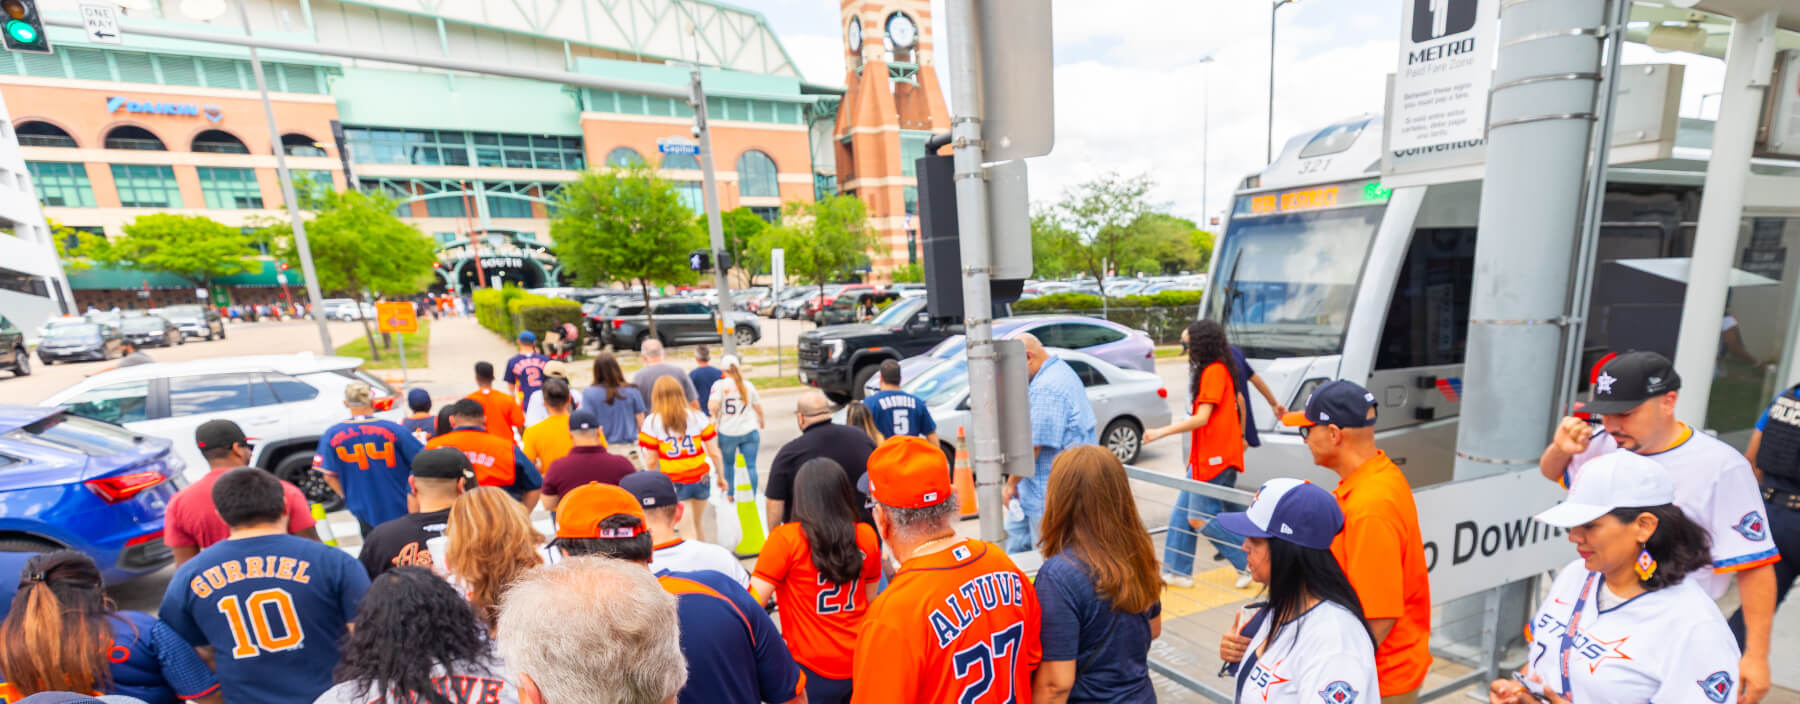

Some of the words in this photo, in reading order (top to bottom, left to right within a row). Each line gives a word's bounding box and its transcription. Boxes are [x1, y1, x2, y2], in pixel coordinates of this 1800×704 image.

[85, 7, 110, 17] ONE
[88, 18, 113, 28] WAY
[1408, 37, 1475, 65] METRO
[126, 101, 199, 116] DAIKIN
[1298, 158, 1333, 175] 321
[1280, 187, 1340, 211] DISTRICT
[525, 367, 543, 387] 2
[725, 398, 747, 415] 67
[1770, 404, 1800, 427] POLIC
[892, 408, 910, 435] 5
[335, 441, 397, 470] 44
[665, 434, 697, 458] 34
[1423, 540, 1439, 573] o
[1452, 516, 1571, 566] Down
[190, 555, 311, 598] GURRIEL
[928, 571, 1023, 649] ALTUVE
[216, 587, 305, 660] 10
[1537, 613, 1607, 660] STOS
[952, 620, 1025, 704] 27
